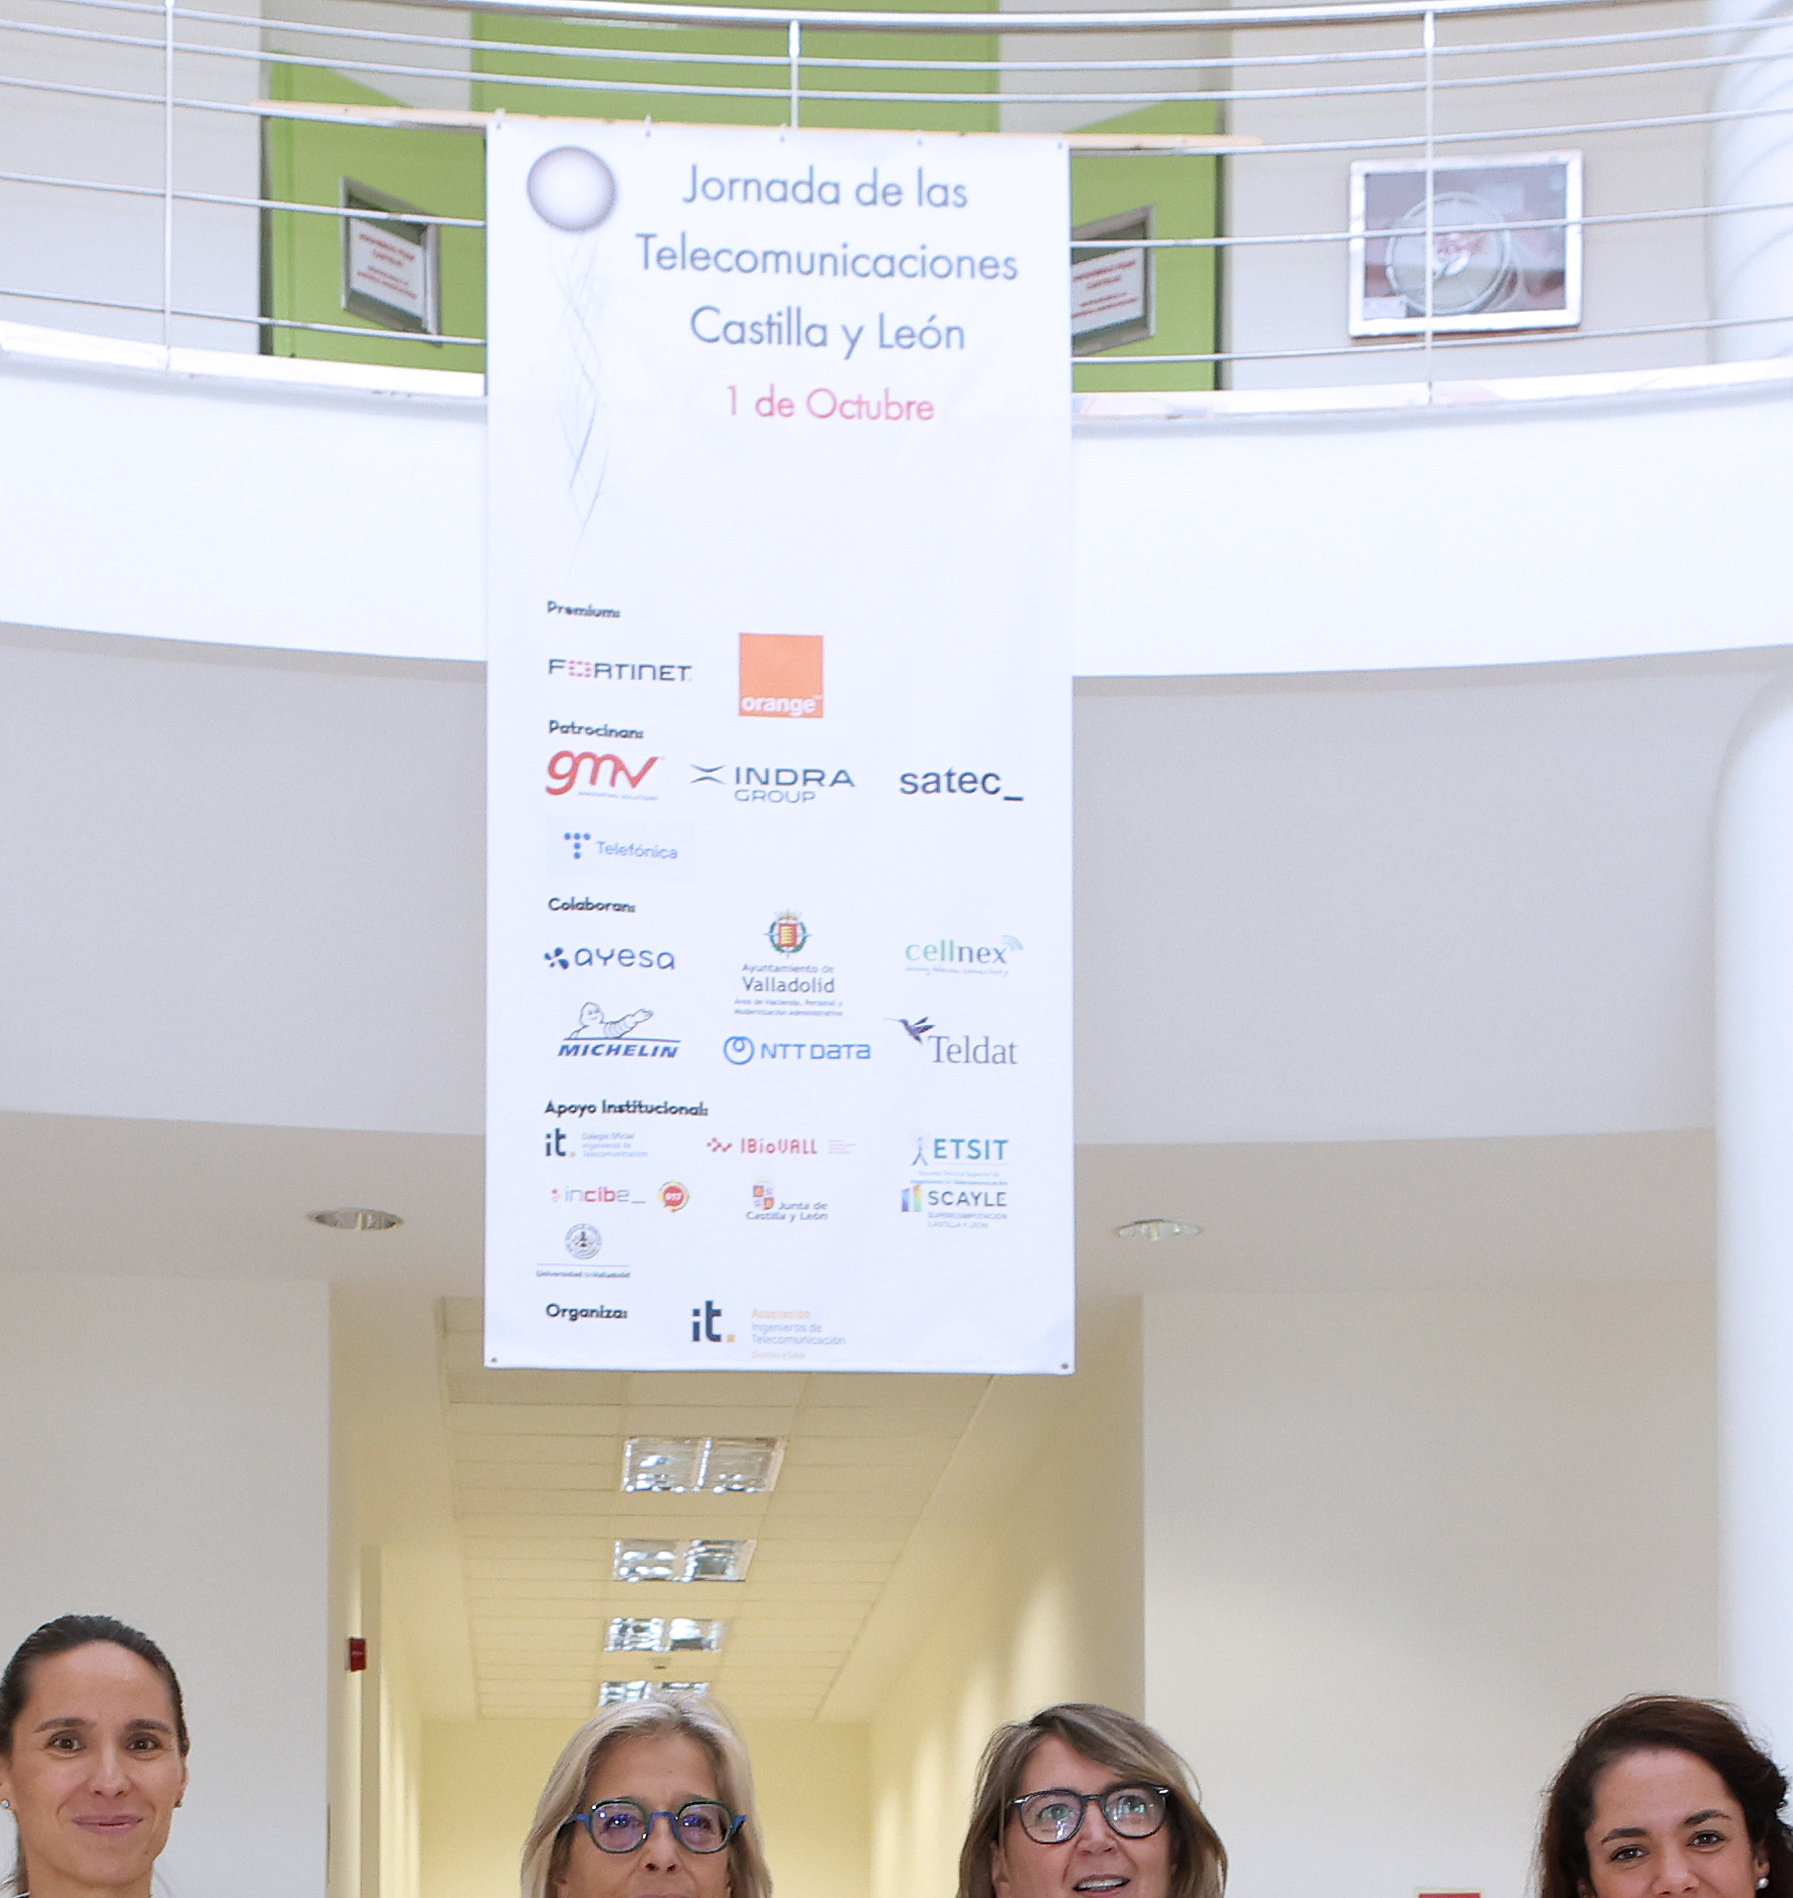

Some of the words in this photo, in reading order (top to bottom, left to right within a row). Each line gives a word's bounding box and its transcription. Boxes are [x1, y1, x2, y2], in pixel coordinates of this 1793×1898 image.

[682, 164, 841, 206] Jornada
[855, 166, 903, 207] de
[918, 167, 969, 209] las
[635, 231, 1019, 281] Telecomunicaciones
[690, 305, 829, 348] Castilla
[841, 325, 864, 360] y
[878, 312, 966, 351] León
[726, 385, 739, 416] 1
[755, 384, 795, 418] de
[806, 387, 935, 421] Octubre
[548, 658, 691, 681] FORTINET
[741, 696, 817, 717] orange
[545, 750, 659, 796] gmv
[734, 766, 856, 787] INDRA
[734, 788, 816, 804] GROUP
[596, 840, 679, 859] Telefónica
[574, 947, 676, 970] ayesa
[905, 938, 1008, 964] cellnex
[742, 976, 835, 993] Valladolid
[557, 1043, 679, 1058] MICHELIN
[761, 1043, 806, 1059] NTT
[927, 1034, 1018, 1065] Teldat
[544, 1099, 597, 1118] Apoyo
[934, 1137, 1009, 1160] ETSIT
[778, 1201, 810, 1211] Junta
[927, 1190, 1008, 1207] SCAYLE
[745, 1211, 786, 1221] Castilla
[546, 1303, 628, 1321] Organiza:
